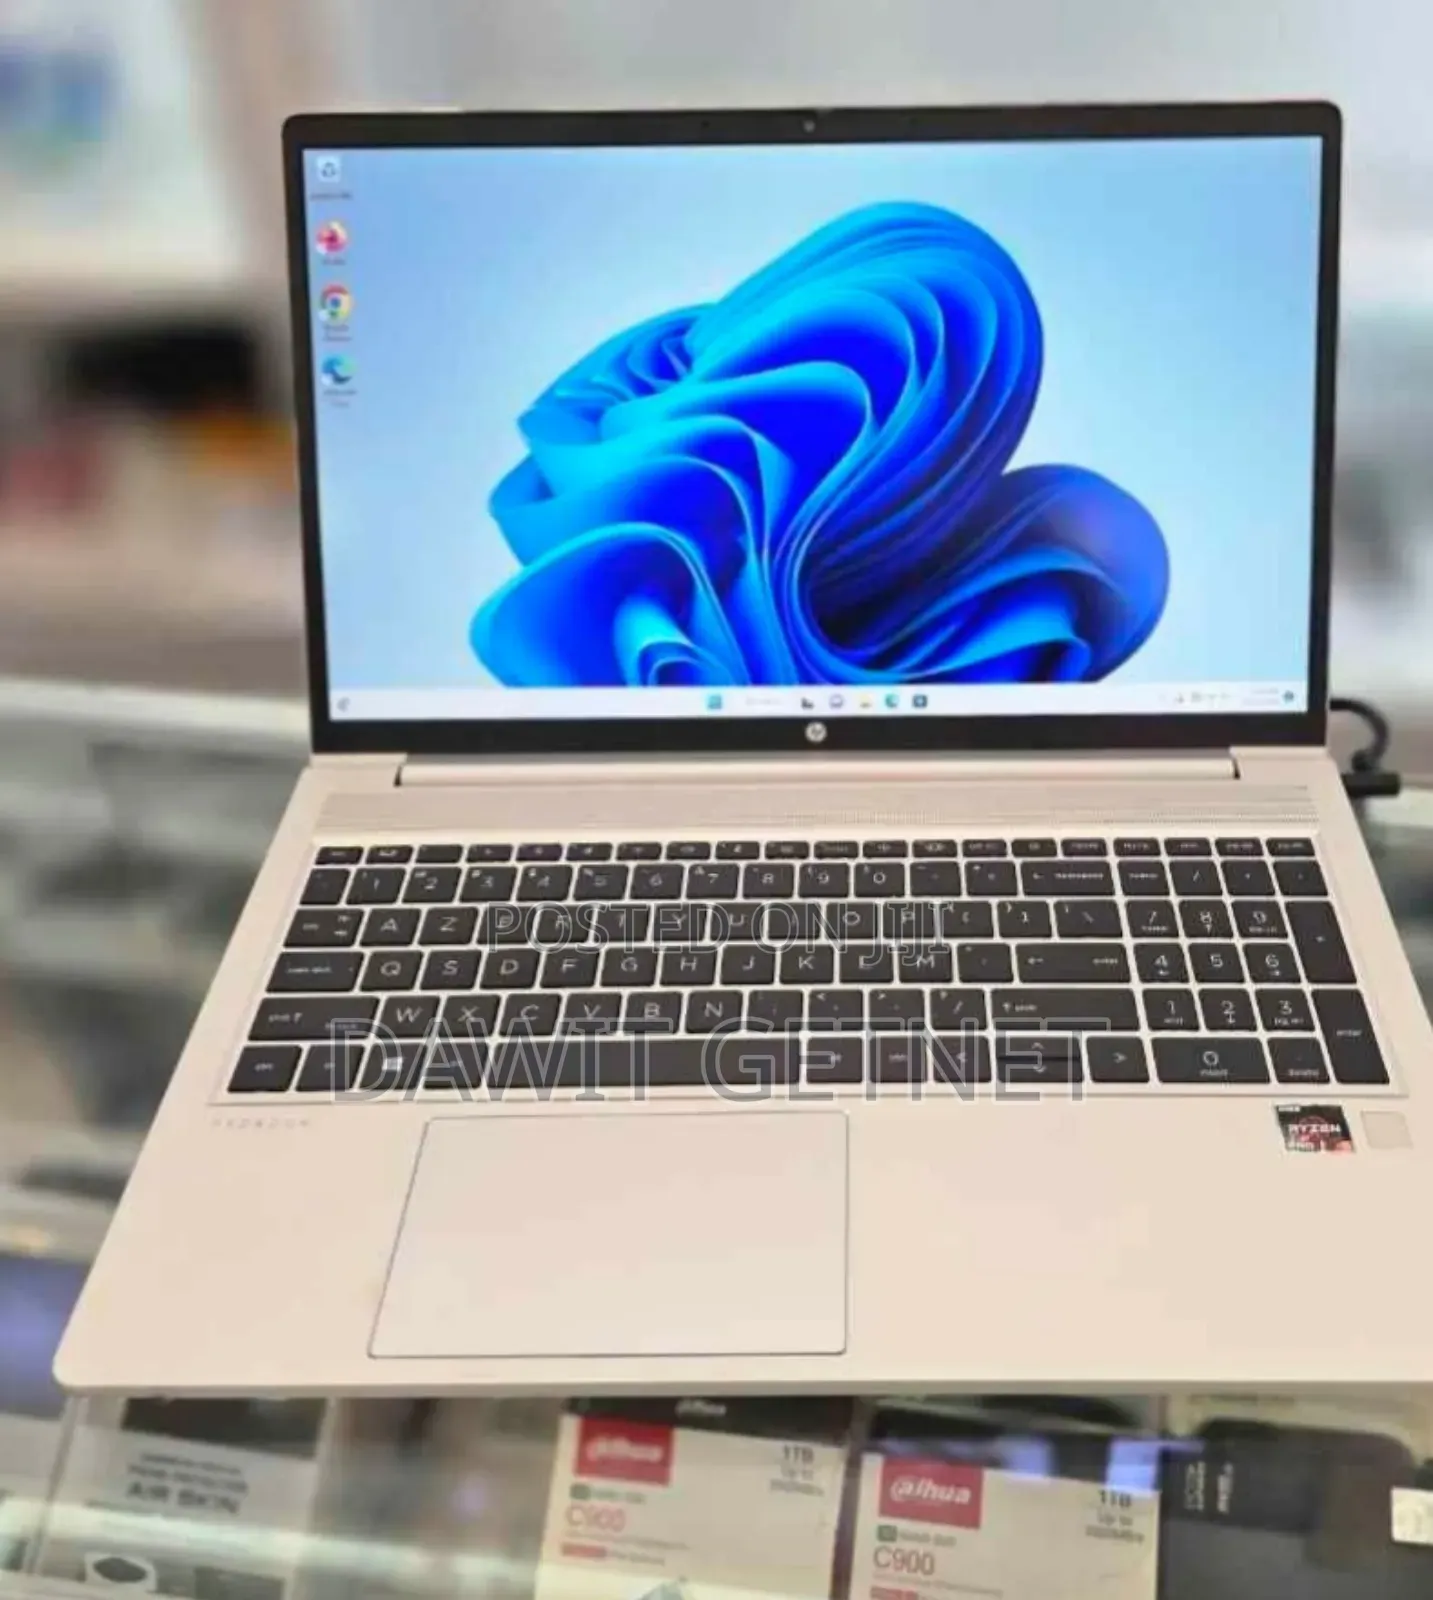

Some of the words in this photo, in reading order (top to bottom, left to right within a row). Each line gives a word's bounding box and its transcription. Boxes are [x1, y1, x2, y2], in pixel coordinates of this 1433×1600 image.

[424, 877, 438, 890] 2
[708, 873, 719, 885] 7
[379, 918, 398, 933] A
[439, 917, 458, 933] Z
[380, 960, 402, 977] Q
[442, 960, 458, 976] S
[500, 959, 519, 974] D
[561, 958, 578, 973] F
[620, 957, 638, 973] G
[680, 956, 697, 971] H
[743, 956, 756, 971] J
[798, 955, 814, 970] K
[916, 954, 935, 969] M
[1155, 954, 1169, 968] 4
[1210, 954, 1224, 968] 5
[1265, 954, 1280, 968] 6
[394, 1005, 423, 1023] W
[457, 1005, 480, 1022] X
[520, 1004, 540, 1021] C
[583, 1003, 602, 1020] V
[644, 1002, 662, 1020] B
[703, 1001, 724, 1018] N
[1221, 1000, 1236, 1015] 2
[1278, 1000, 1292, 1015] 3
[872, 1546, 937, 1577] C900
